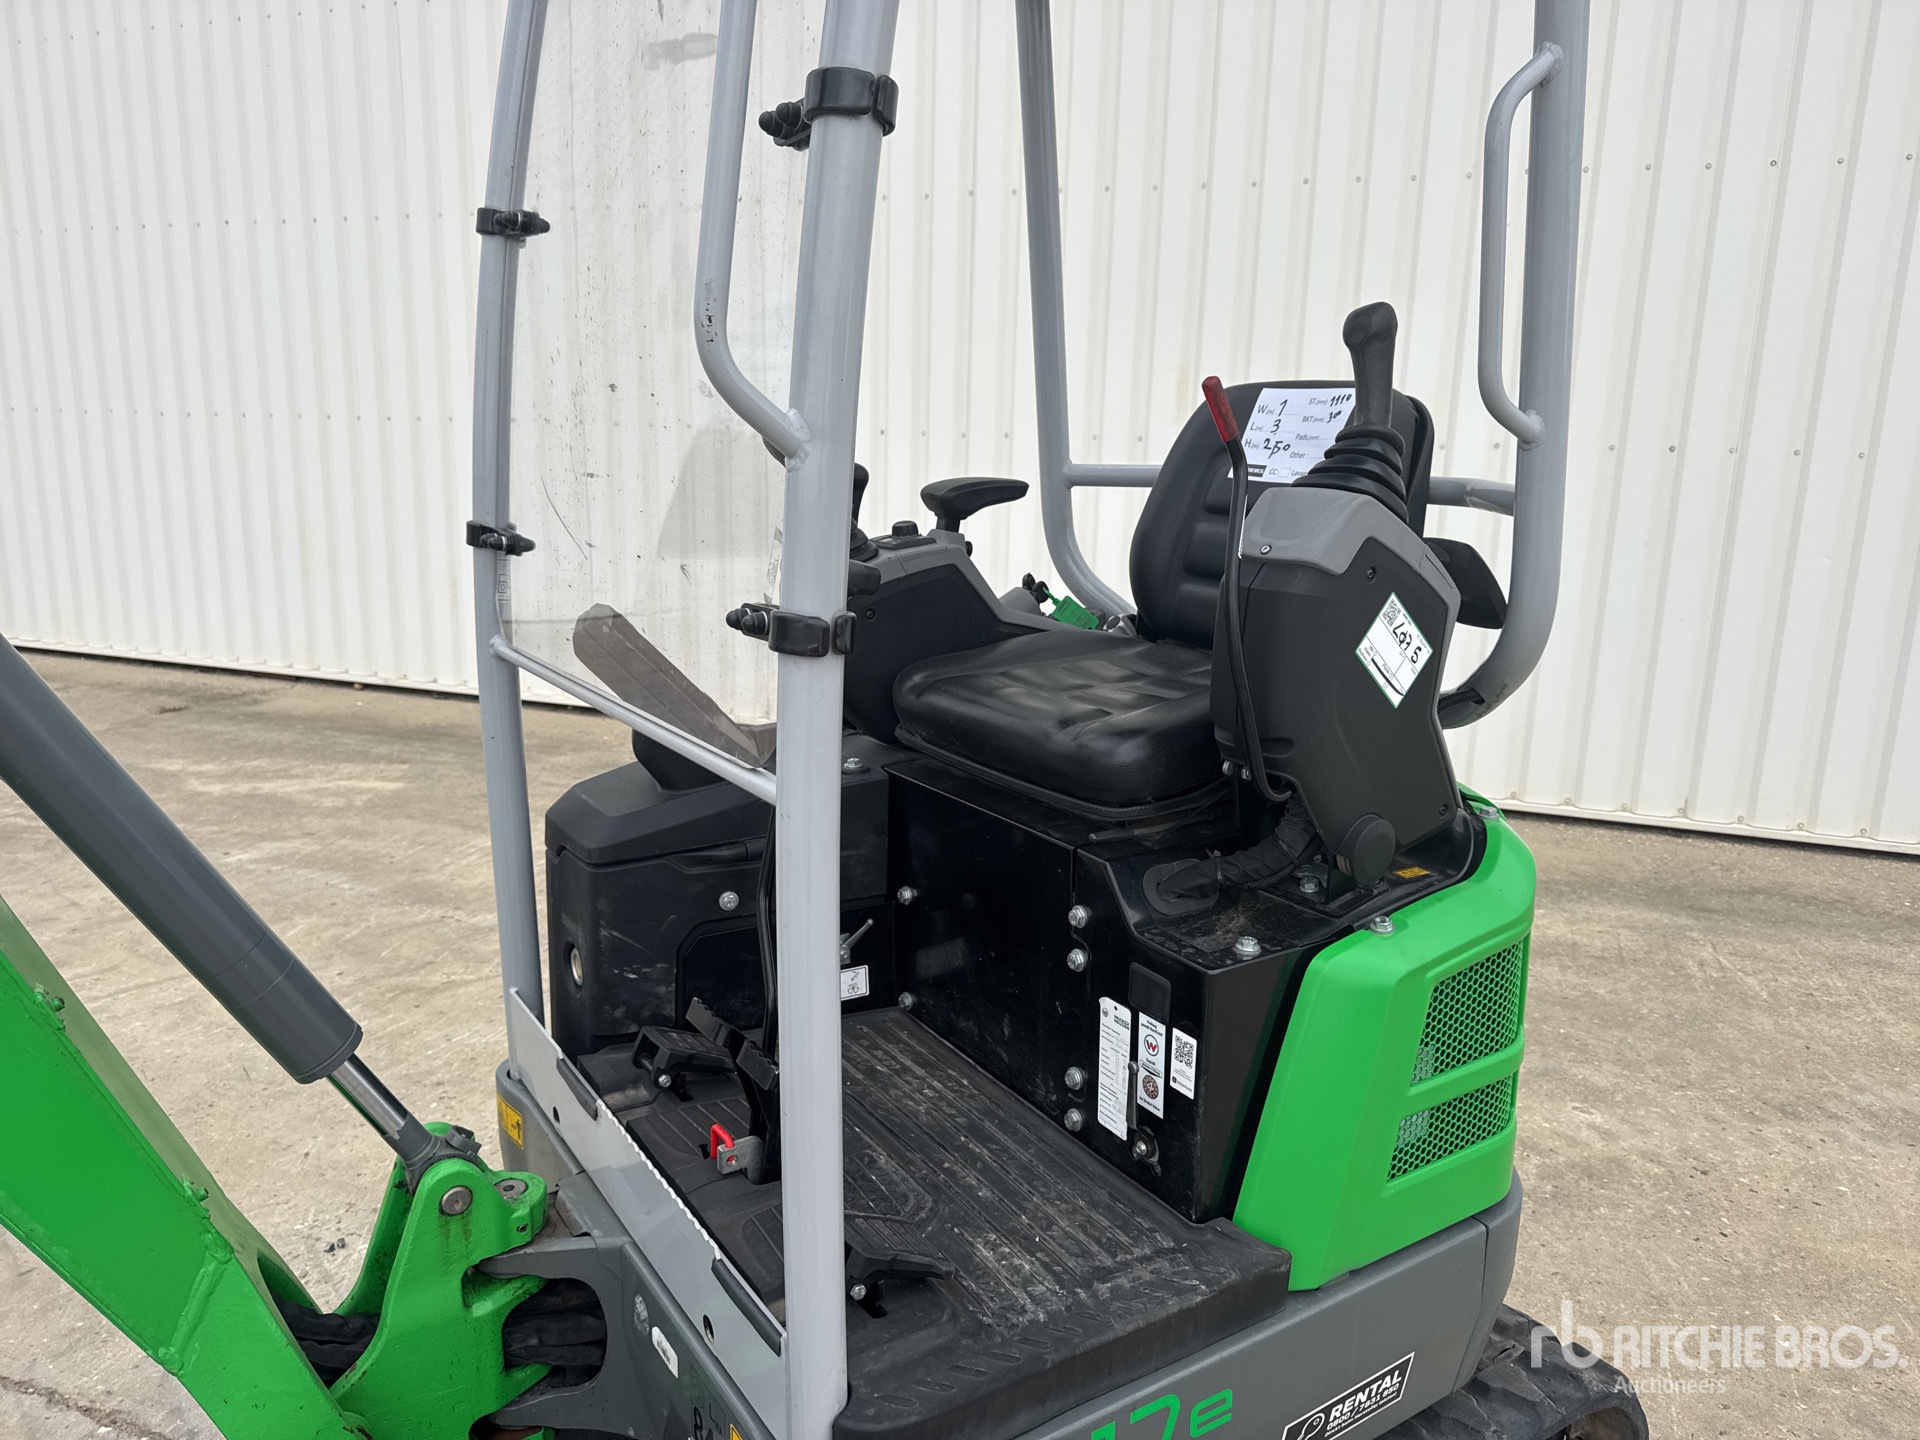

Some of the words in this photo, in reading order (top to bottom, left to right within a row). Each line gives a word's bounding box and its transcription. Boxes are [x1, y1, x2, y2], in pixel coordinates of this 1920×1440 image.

[1278, 399, 1288, 417] 1
[1330, 394, 1352, 407] 1110
[1329, 1370, 1402, 1422] RENTAL
